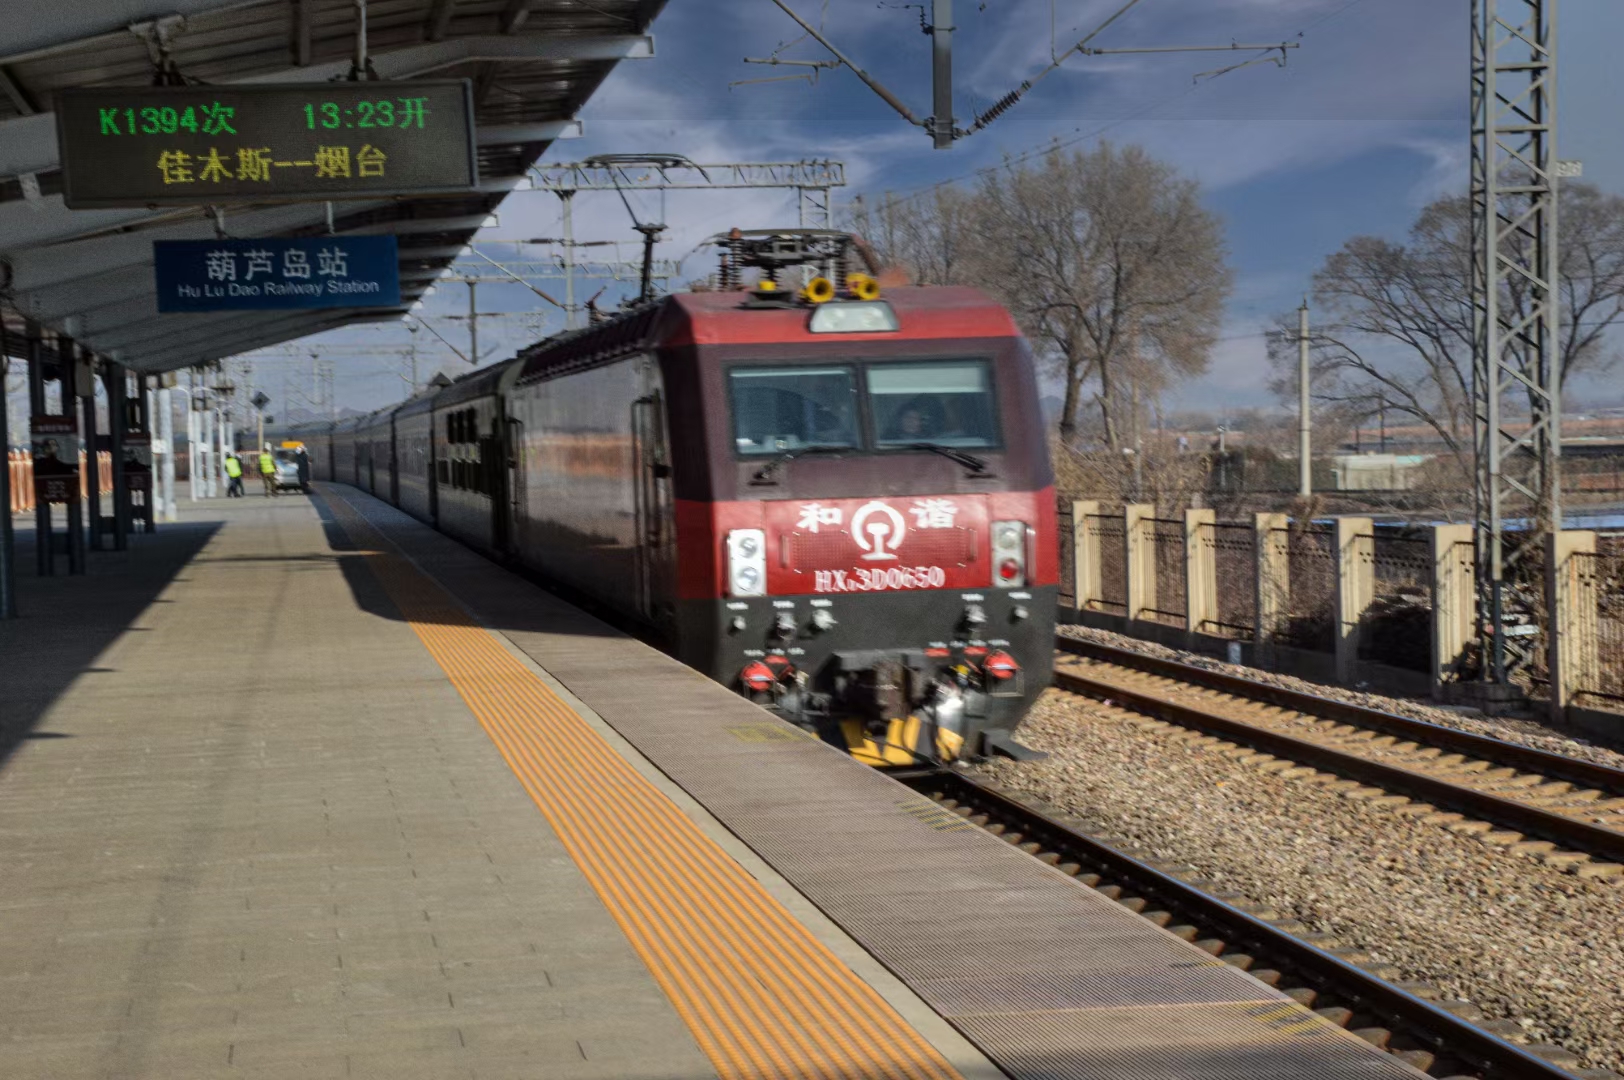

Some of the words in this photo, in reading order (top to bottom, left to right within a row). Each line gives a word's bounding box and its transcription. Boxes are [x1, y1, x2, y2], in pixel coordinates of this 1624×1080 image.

[99, 101, 237, 135] K1394次
[304, 97, 431, 130] 13:23开
[206, 247, 348, 281] 葫芦岛站
[178, 284, 201, 298] Hu
[204, 283, 225, 297] Lu
[228, 282, 260, 296] Dao
[264, 280, 323, 297] Railway
[327, 279, 380, 293] Station
[796, 504, 843, 533] 和
[909, 499, 958, 528] 谐
